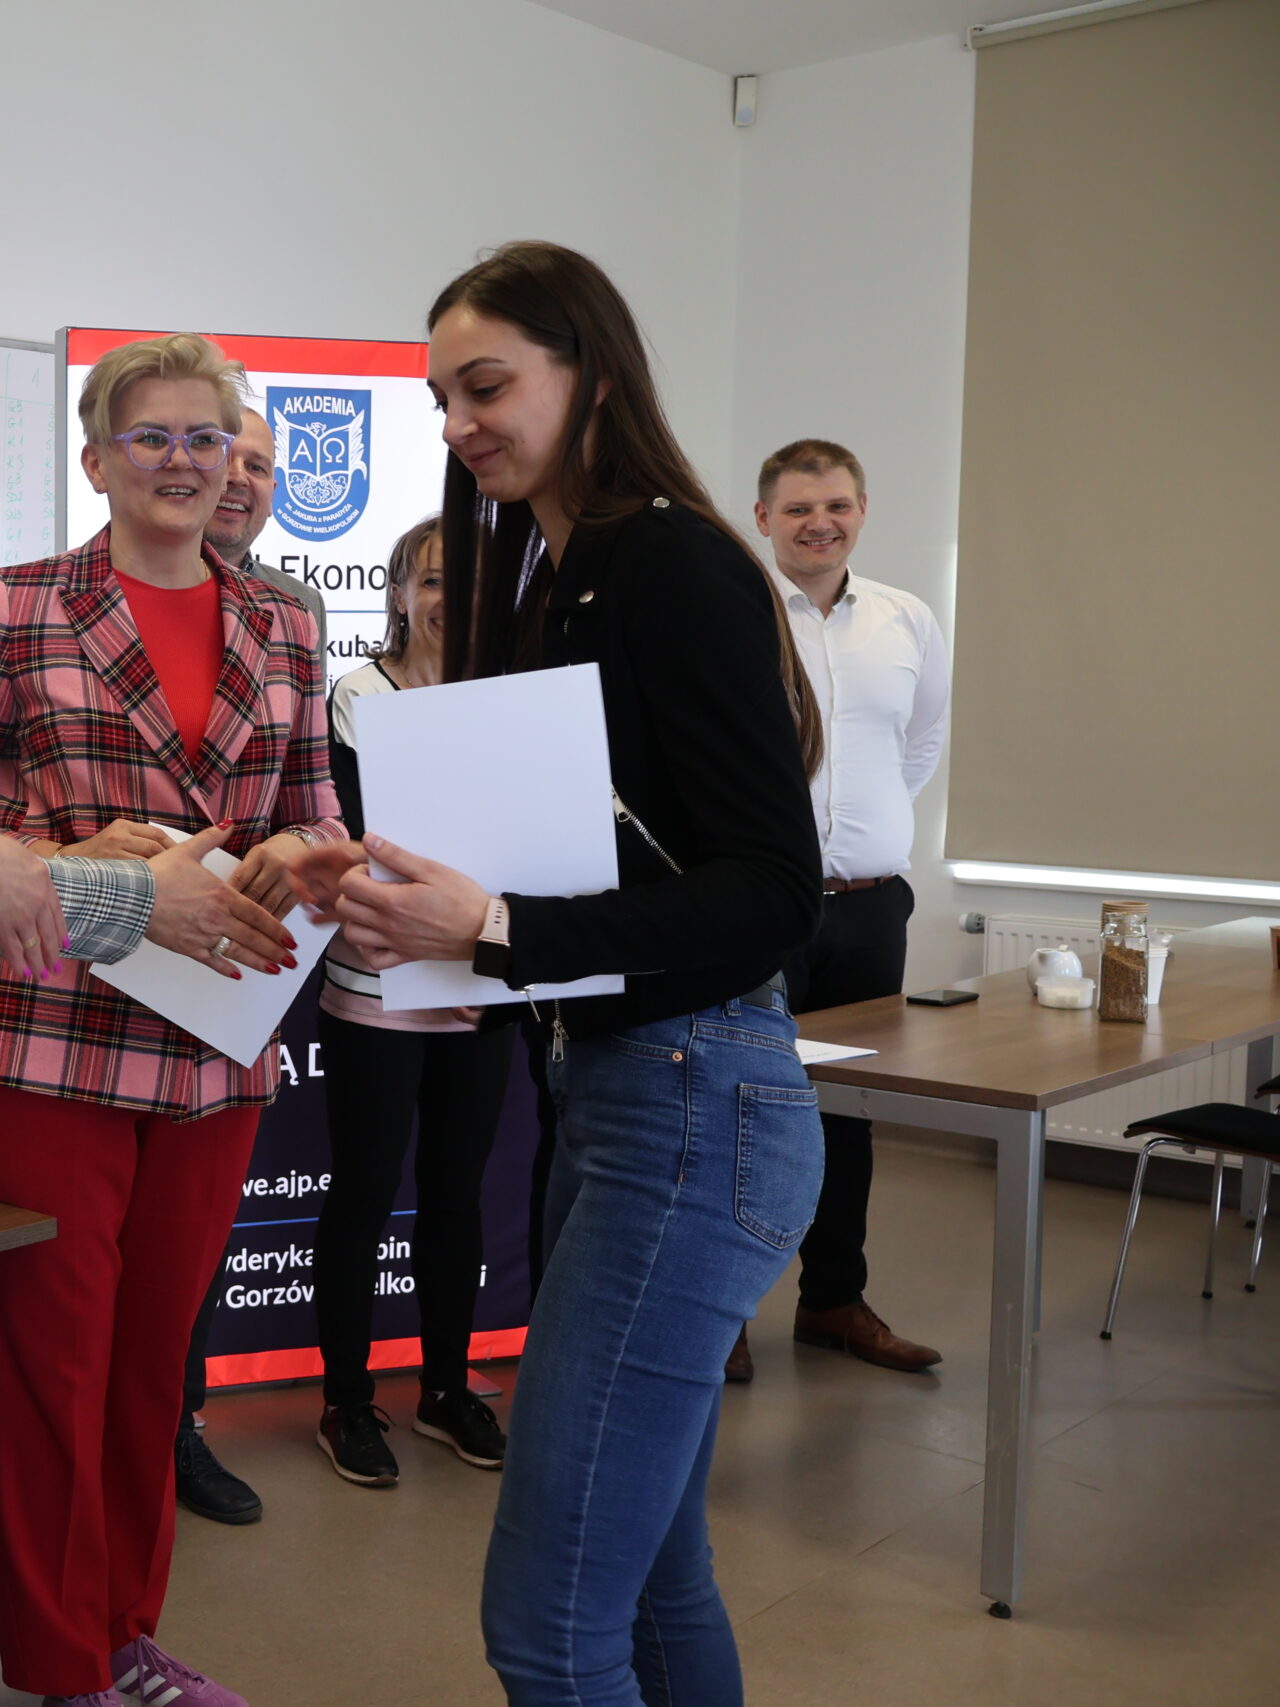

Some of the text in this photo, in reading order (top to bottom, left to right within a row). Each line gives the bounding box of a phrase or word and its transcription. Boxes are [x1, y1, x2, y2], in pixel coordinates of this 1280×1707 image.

[283, 395, 356, 417] AKADEMIA
[323, 437, 346, 463] Ω
[225, 1244, 314, 1274] deryka
